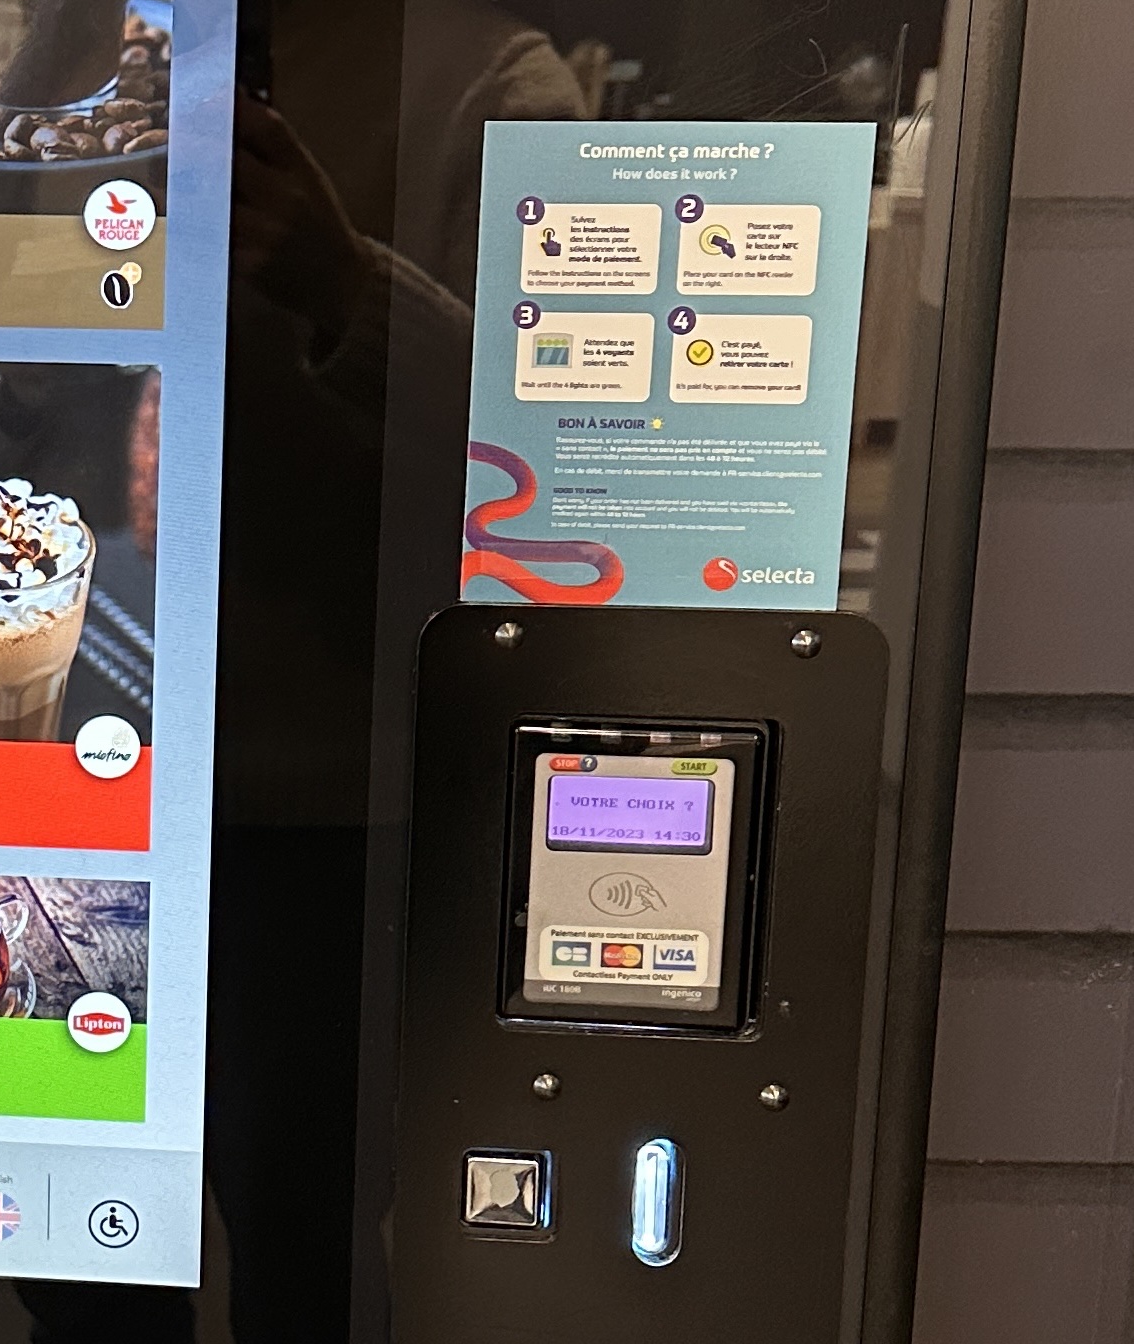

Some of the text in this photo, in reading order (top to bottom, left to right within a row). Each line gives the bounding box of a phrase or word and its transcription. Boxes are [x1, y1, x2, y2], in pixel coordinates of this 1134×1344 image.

[579, 143, 775, 162] Comment ça marche ?
[613, 168, 738, 180] How does it work ?
[525, 201, 538, 220] 1
[681, 198, 697, 217] 2
[95, 218, 144, 229] PELICAN
[583, 225, 630, 233] instructions
[99, 229, 140, 240] ROUGE
[782, 242, 799, 250] NFC
[519, 306, 534, 324] 3
[673, 311, 689, 329] 4
[584, 338, 618, 346] Attendez
[558, 415, 646, 430] BON À SAVOIR
[741, 567, 815, 585] selecta
[556, 758, 593, 768] STOP ?
[681, 763, 707, 771] START
[571, 796, 694, 811] VOTRE CHOIX ?
[552, 826, 701, 842] 18/11/2023 14:30
[551, 929, 586, 939] Paiement
[606, 932, 634, 940] contact
[636, 932, 699, 942] EXCLUSIVEMENT
[659, 949, 695, 962] VISA
[573, 970, 674, 982] Contactless Payment ONLY
[661, 989, 702, 999] ingenico
[74, 1016, 123, 1033] Lipton
